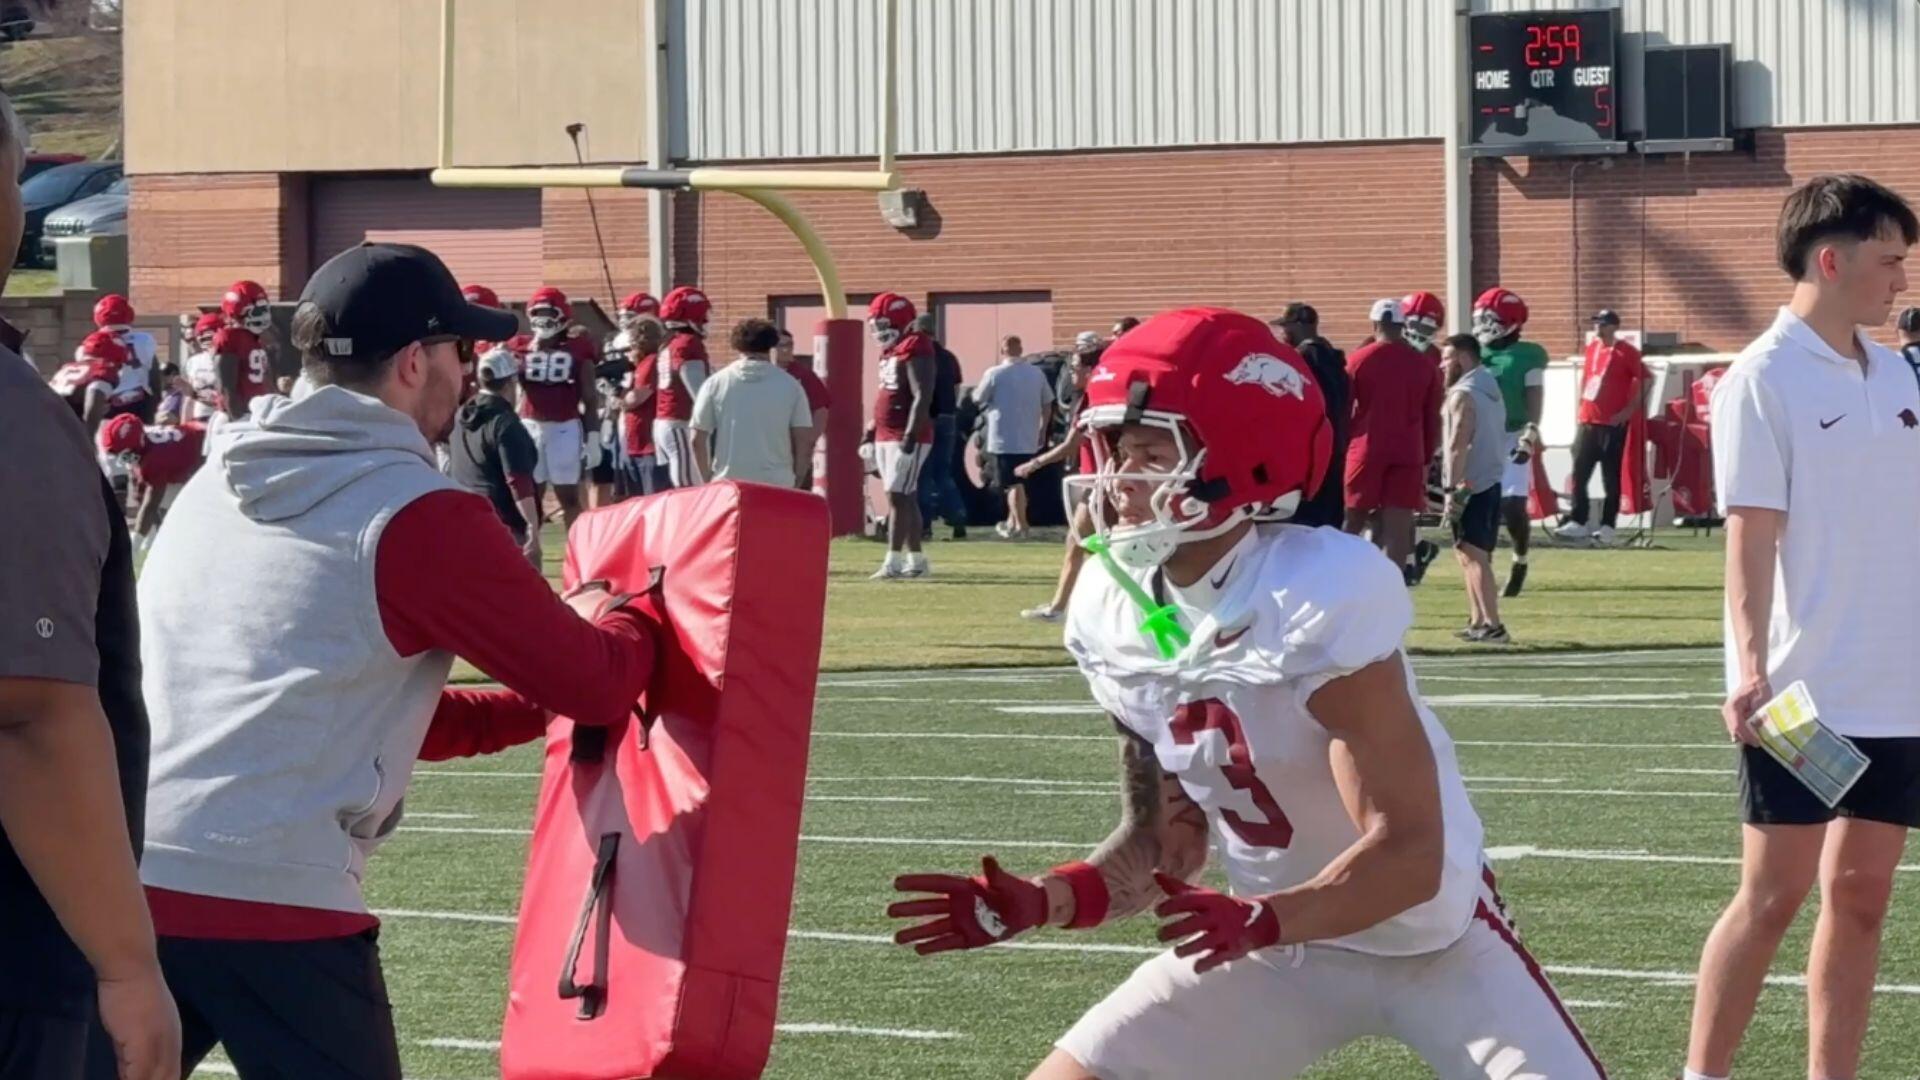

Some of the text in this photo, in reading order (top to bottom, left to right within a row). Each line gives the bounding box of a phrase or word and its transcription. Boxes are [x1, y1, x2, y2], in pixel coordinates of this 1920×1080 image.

[1525, 24, 1580, 66] 2:59
[1476, 67, 1610, 89] HOME QTR GUEST
[525, 351, 572, 382] 88
[1168, 697, 1294, 849] 3
